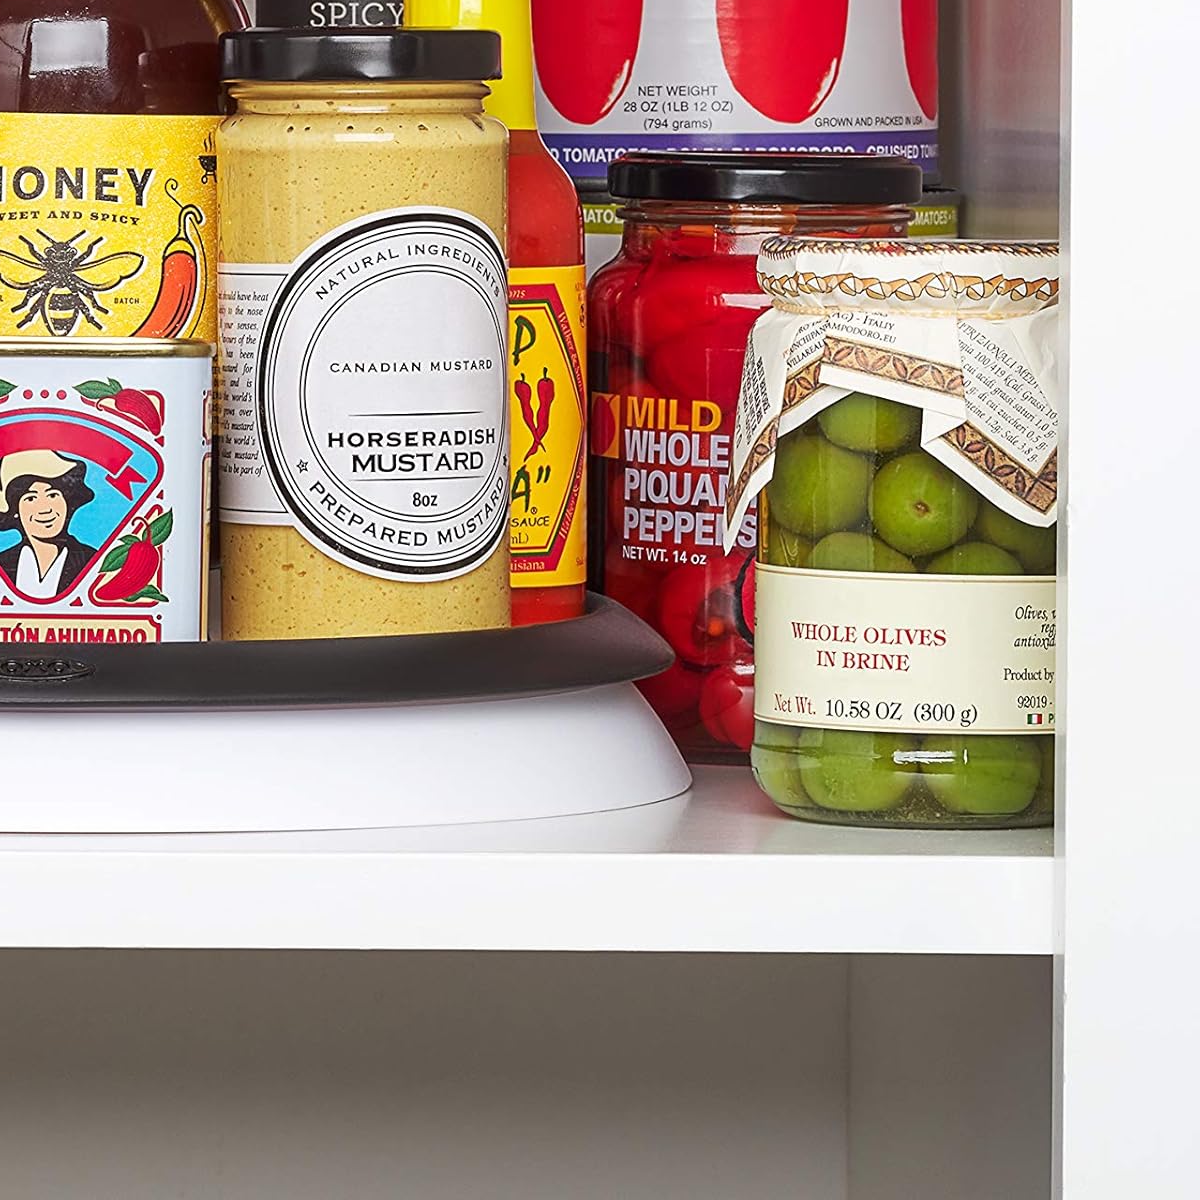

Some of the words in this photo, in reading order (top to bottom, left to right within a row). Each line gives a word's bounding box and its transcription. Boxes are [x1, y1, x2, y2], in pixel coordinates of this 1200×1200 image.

[309, 2, 404, 27] SPICY
[638, 85, 662, 97] NET
[667, 85, 718, 97] WEIGHT
[623, 101, 637, 113] 28
[640, 101, 658, 113] OZ
[662, 101, 689, 114] (1LB
[695, 101, 707, 112] 12
[711, 101, 734, 114] OZ)
[643, 119, 669, 131] (794
[672, 119, 713, 132] grams)
[814, 117, 853, 128] GROWN
[855, 117, 873, 126] AND
[875, 116, 904, 126] PACKED
[47, 210, 83, 220] AND
[90, 212, 141, 227] SPICY
[315, 248, 400, 301] NATURAL
[407, 244, 500, 298] INGREDIENTS
[113, 297, 140, 306] BATCH
[329, 361, 422, 373] CANADIAN
[430, 359, 493, 372] MUSTARD
[627, 396, 722, 432] MILD
[327, 428, 496, 449] HORSERADISH
[624, 428, 730, 468] WHOLE
[352, 451, 484, 473] MUSTARD
[624, 467, 729, 507] PIQUAN
[412, 492, 438, 507] 8oz
[309, 480, 429, 547] PREPARED
[436, 476, 504, 545] MUSTARD
[511, 516, 550, 527] SAUCE
[622, 545, 644, 561] NET
[646, 548, 669, 563] WT.
[673, 550, 688, 564] 14
[1015, 605, 1049, 622] Olives,
[791, 621, 858, 644] WHOLE
[863, 626, 948, 647] OLIVES
[816, 650, 836, 668] IN
[843, 652, 911, 673] BRINE
[1003, 667, 1042, 681] Product
[1044, 667, 1055, 684] by
[774, 693, 792, 713] Net
[795, 696, 817, 716] Wt.
[825, 699, 870, 720] 10.58
[875, 701, 903, 721] OZ
[914, 703, 955, 724] (300
[960, 704, 978, 728] g)
[1018, 695, 1048, 709] 92019
